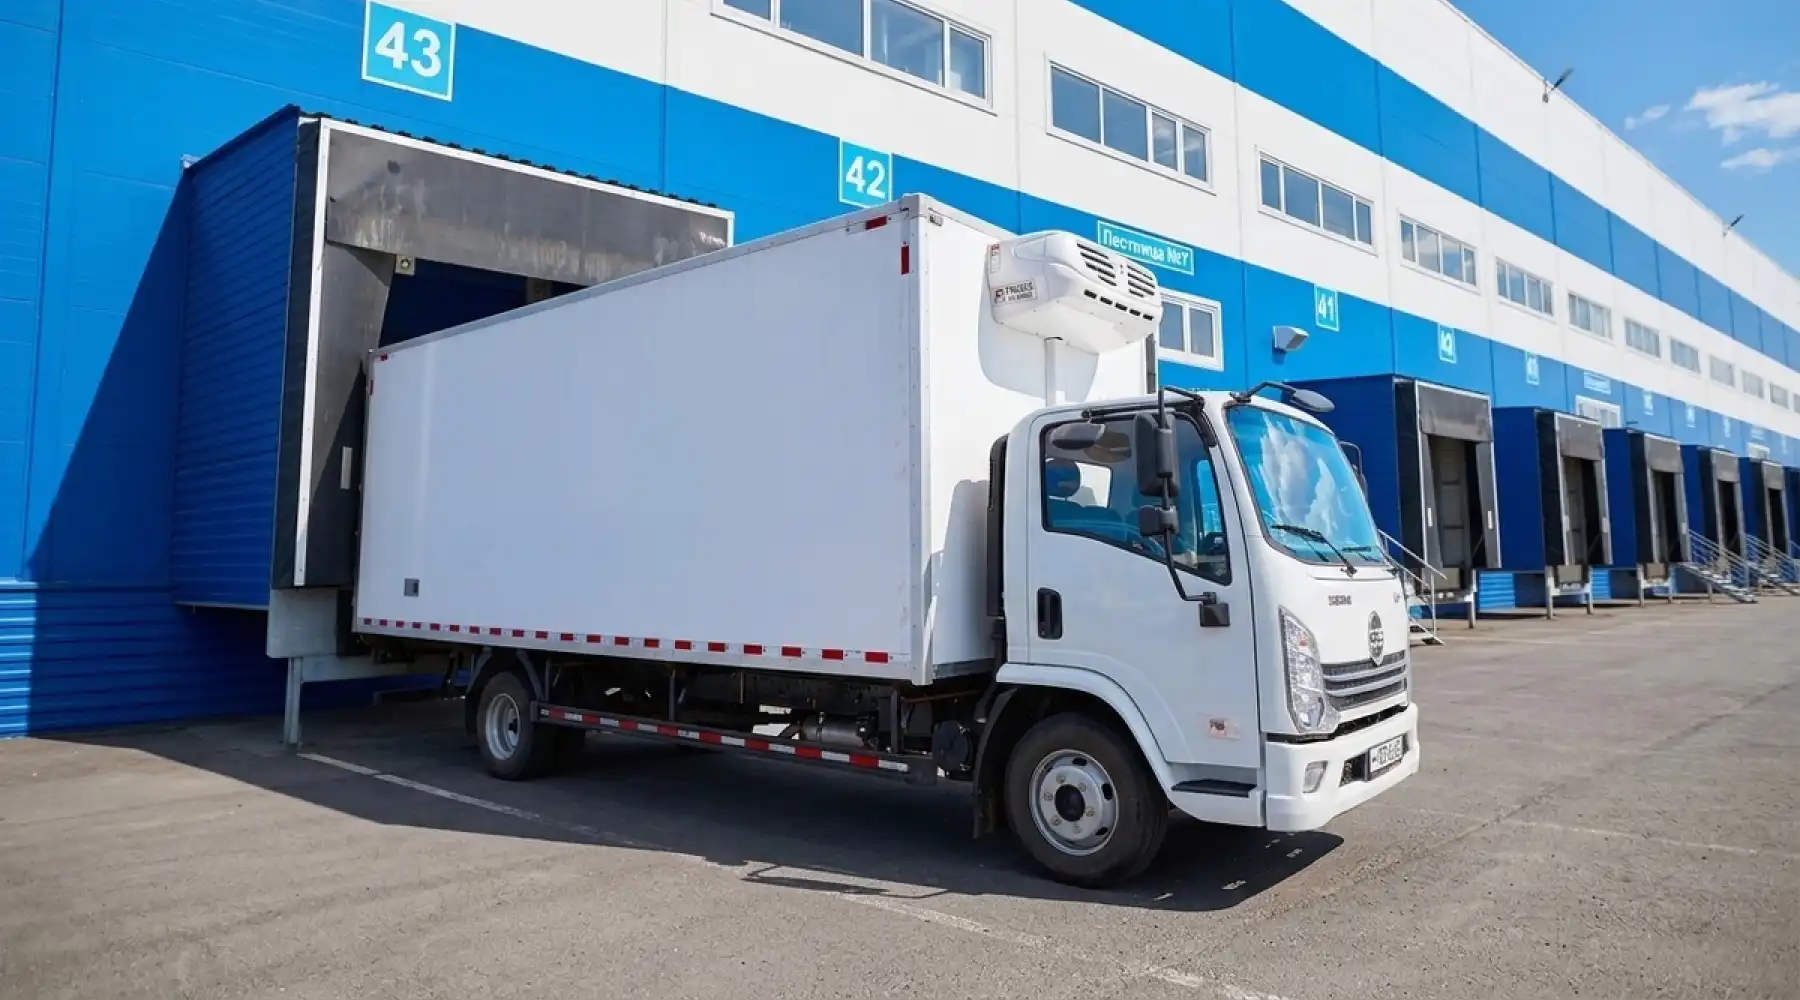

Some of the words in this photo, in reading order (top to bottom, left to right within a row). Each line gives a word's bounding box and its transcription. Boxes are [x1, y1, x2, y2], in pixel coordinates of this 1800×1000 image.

[375, 21, 442, 77] 43
[846, 155, 886, 199] 42
[1318, 293, 1335, 322] 41
